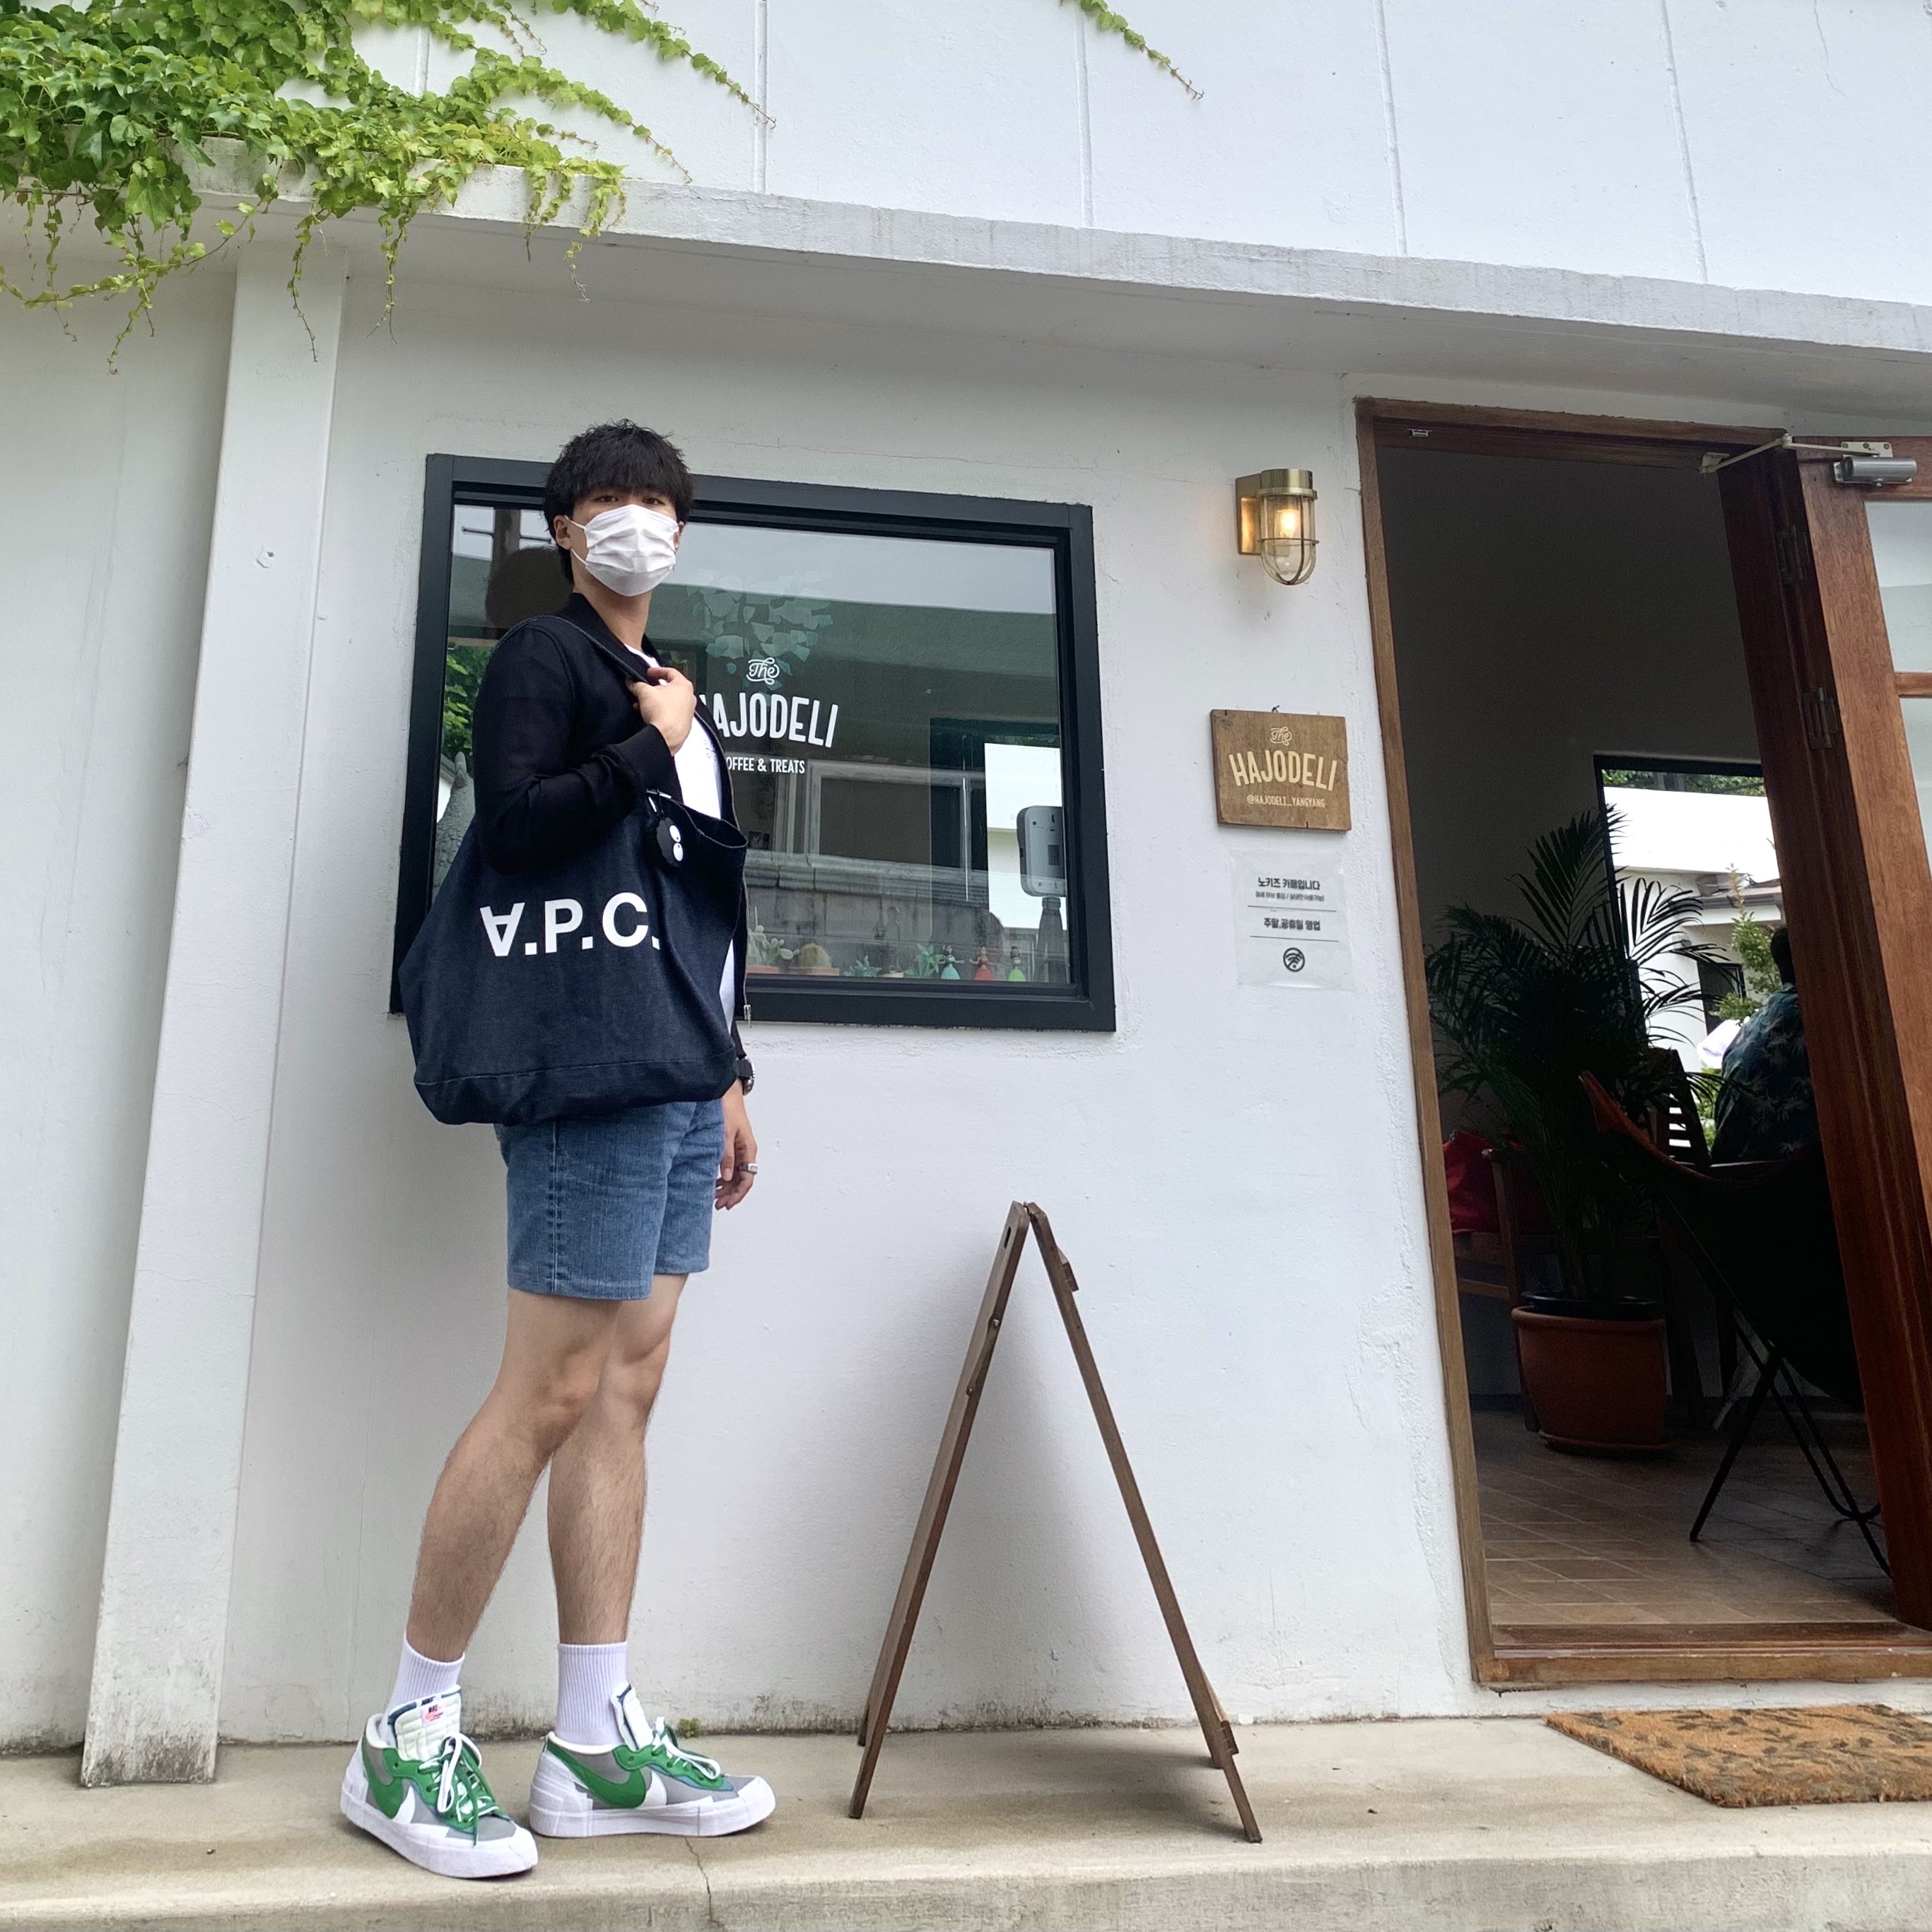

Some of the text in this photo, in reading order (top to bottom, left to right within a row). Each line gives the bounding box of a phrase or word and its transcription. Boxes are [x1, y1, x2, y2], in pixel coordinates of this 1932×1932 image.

[746, 657, 780, 685] The
[1270, 726, 1292, 746] The
[726, 756, 805, 774] OFFEE & TREATS
[1229, 749, 1337, 791] HAJODELI
[1258, 877, 1281, 888] 노키즈
[1306, 920, 1321, 931] 영업
